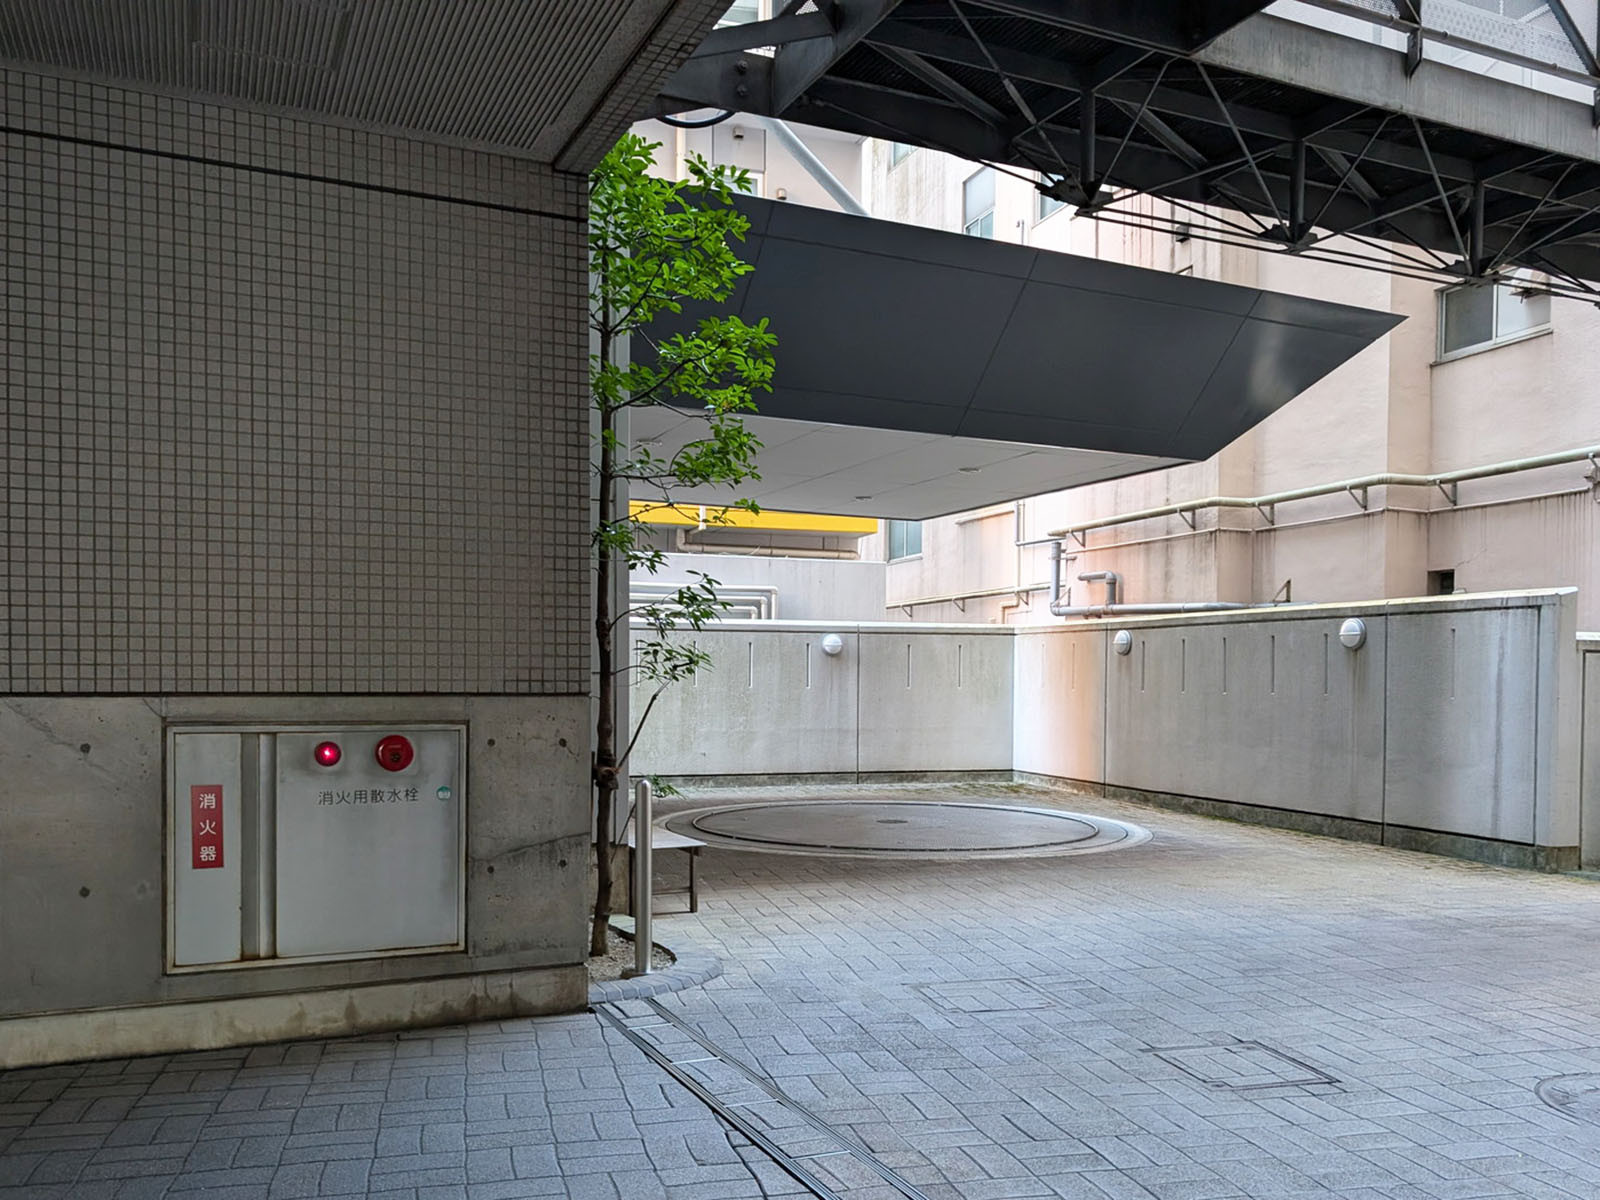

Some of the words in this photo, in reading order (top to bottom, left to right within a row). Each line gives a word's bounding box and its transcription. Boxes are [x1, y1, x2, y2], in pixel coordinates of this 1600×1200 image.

[318, 787, 419, 806] 消火用散水栓
[199, 793, 217, 862] 消火器
